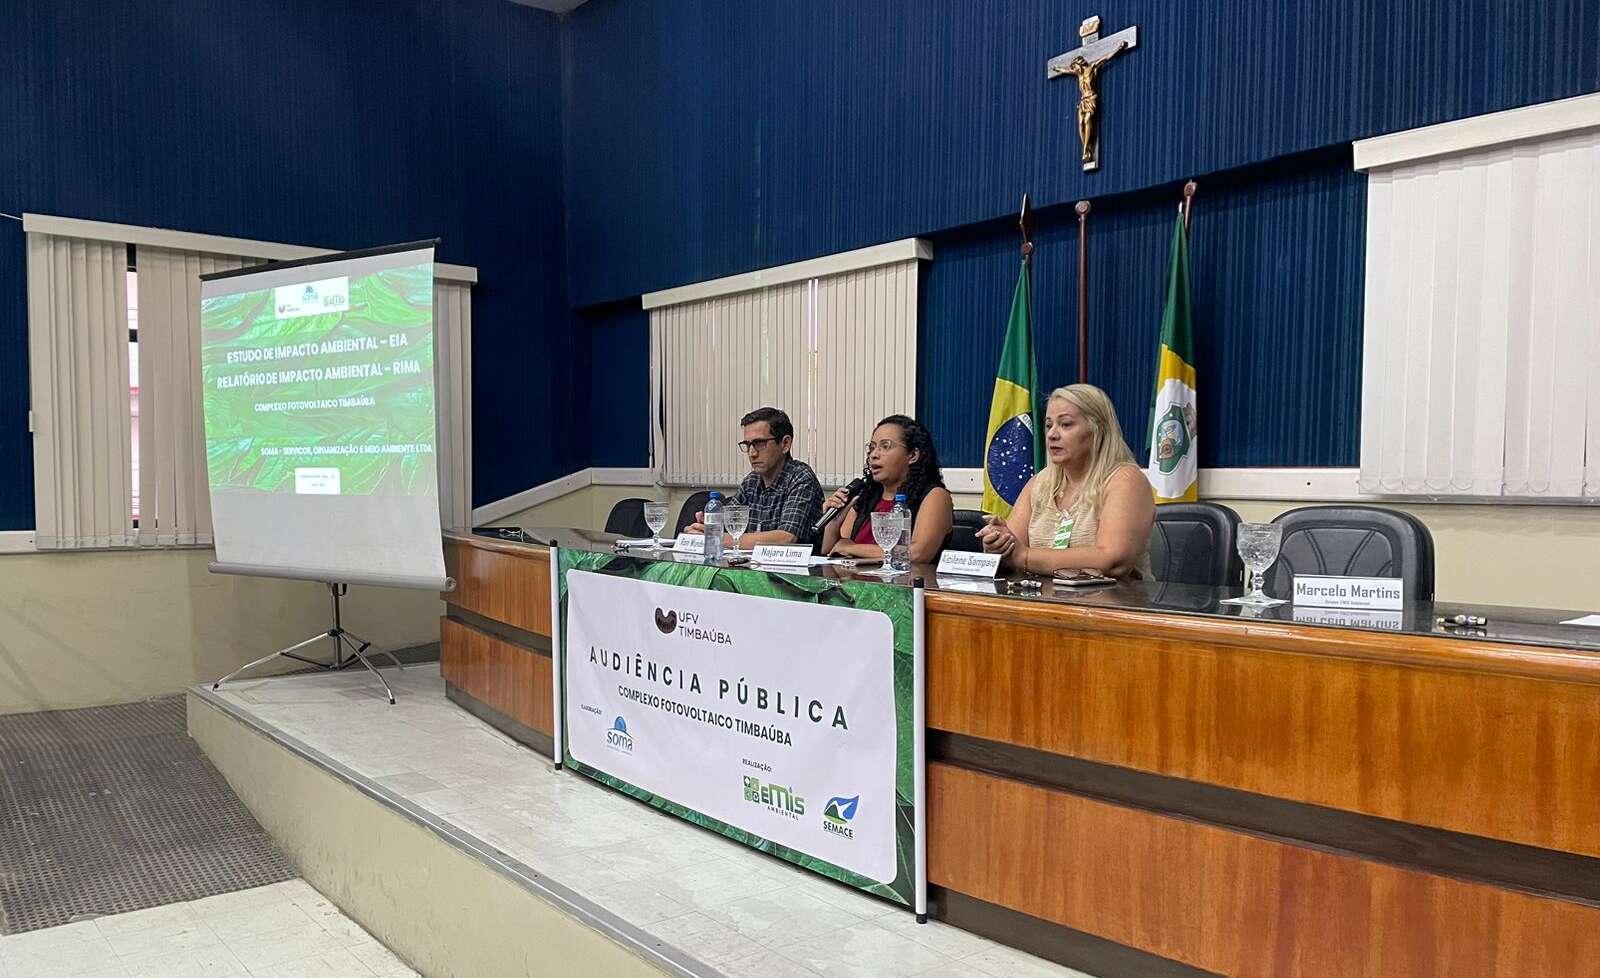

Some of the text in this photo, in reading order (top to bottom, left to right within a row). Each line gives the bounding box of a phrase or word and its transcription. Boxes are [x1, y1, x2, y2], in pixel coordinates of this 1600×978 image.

[226, 349, 262, 364] ESTUDO
[263, 348, 274, 360] DE
[274, 343, 319, 359] IMPACTO
[320, 336, 379, 354] AMBIENTAL
[389, 333, 408, 347] EIA
[217, 372, 266, 389] RELATÓRIO
[266, 372, 278, 385] DE
[279, 368, 323, 384] IMPACTO
[324, 363, 383, 380] AMBIENTAL
[393, 360, 421, 375] RIMA
[254, 403, 287, 412] COMPLEXO
[287, 400, 338, 410] FOTOVOLTAICO
[761, 546, 802, 558] Najara Lima
[967, 555, 997, 568] Sampaio
[1296, 583, 1400, 599] Marcelo Martins
[678, 611, 699, 624] UFV
[678, 626, 732, 646] TIMBAÚBA
[589, 645, 849, 731] AUDIÊNCIA PÚBLICA
[617, 685, 793, 748] COMPLEXO FOTOVOLTAICO TIMBAÚBA
[606, 731, 633, 751] soma
[766, 804, 799, 821] AMBIENTAL
[823, 820, 854, 839] SEMACE
